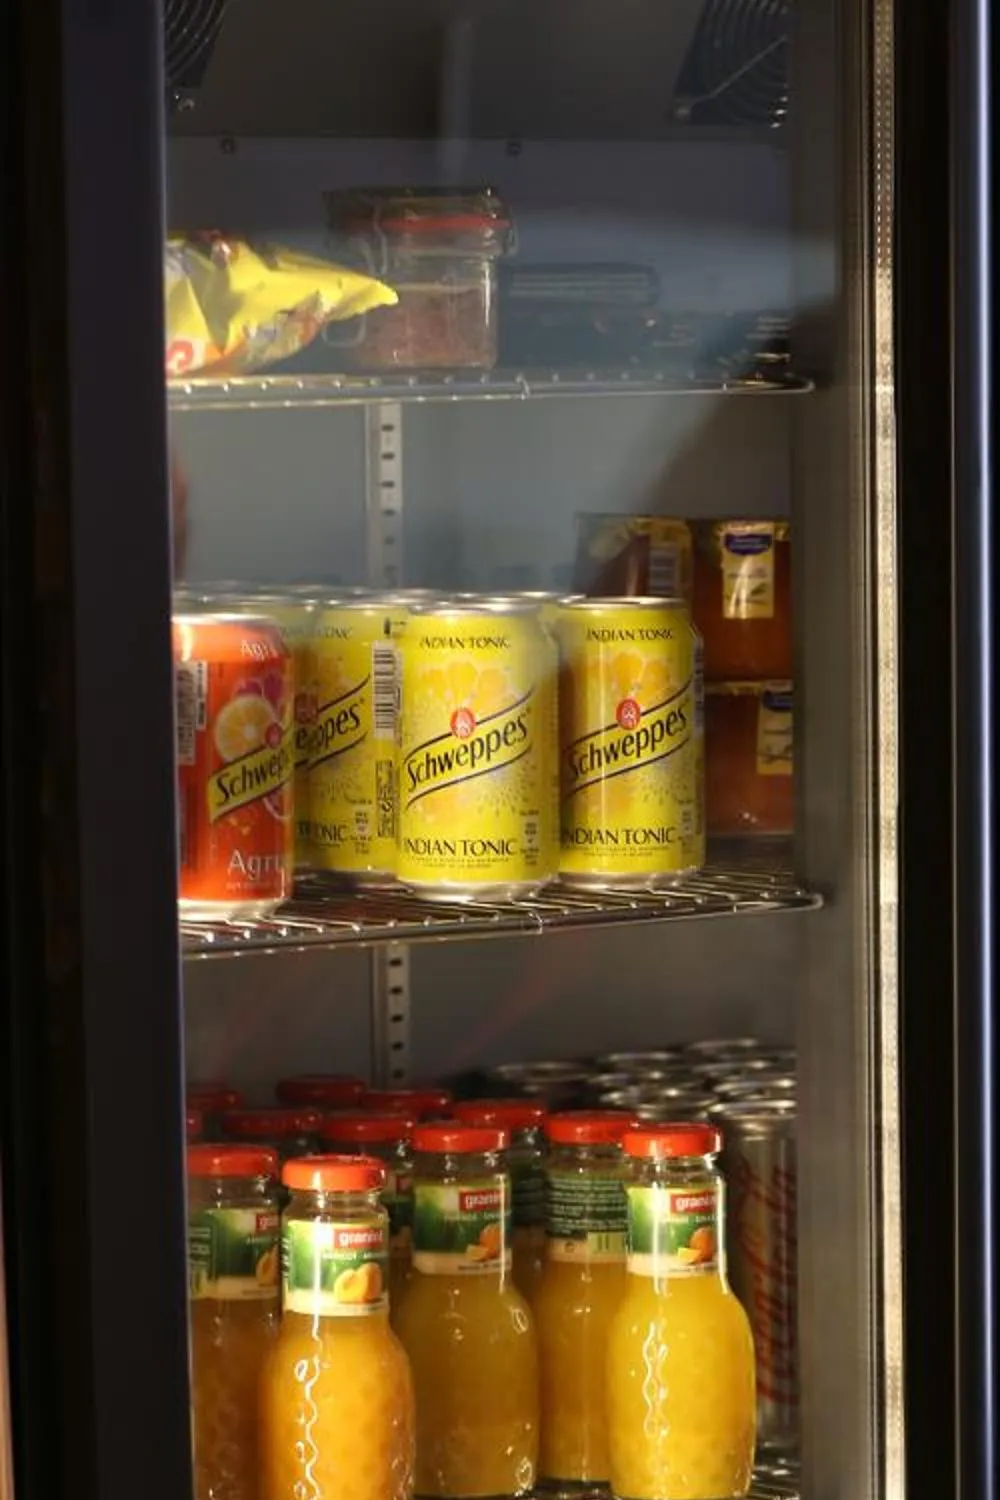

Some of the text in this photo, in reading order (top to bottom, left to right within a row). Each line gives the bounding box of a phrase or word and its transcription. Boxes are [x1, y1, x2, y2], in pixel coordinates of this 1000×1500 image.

[419, 636, 512, 650] INDIAN TONIC
[587, 628, 637, 641] INDIAN
[295, 702, 361, 752] eppes
[406, 711, 529, 792] Schweppes
[568, 706, 688, 780] Schweppes
[620, 826, 678, 846] TONIC
[460, 838, 518, 857] TONIC
